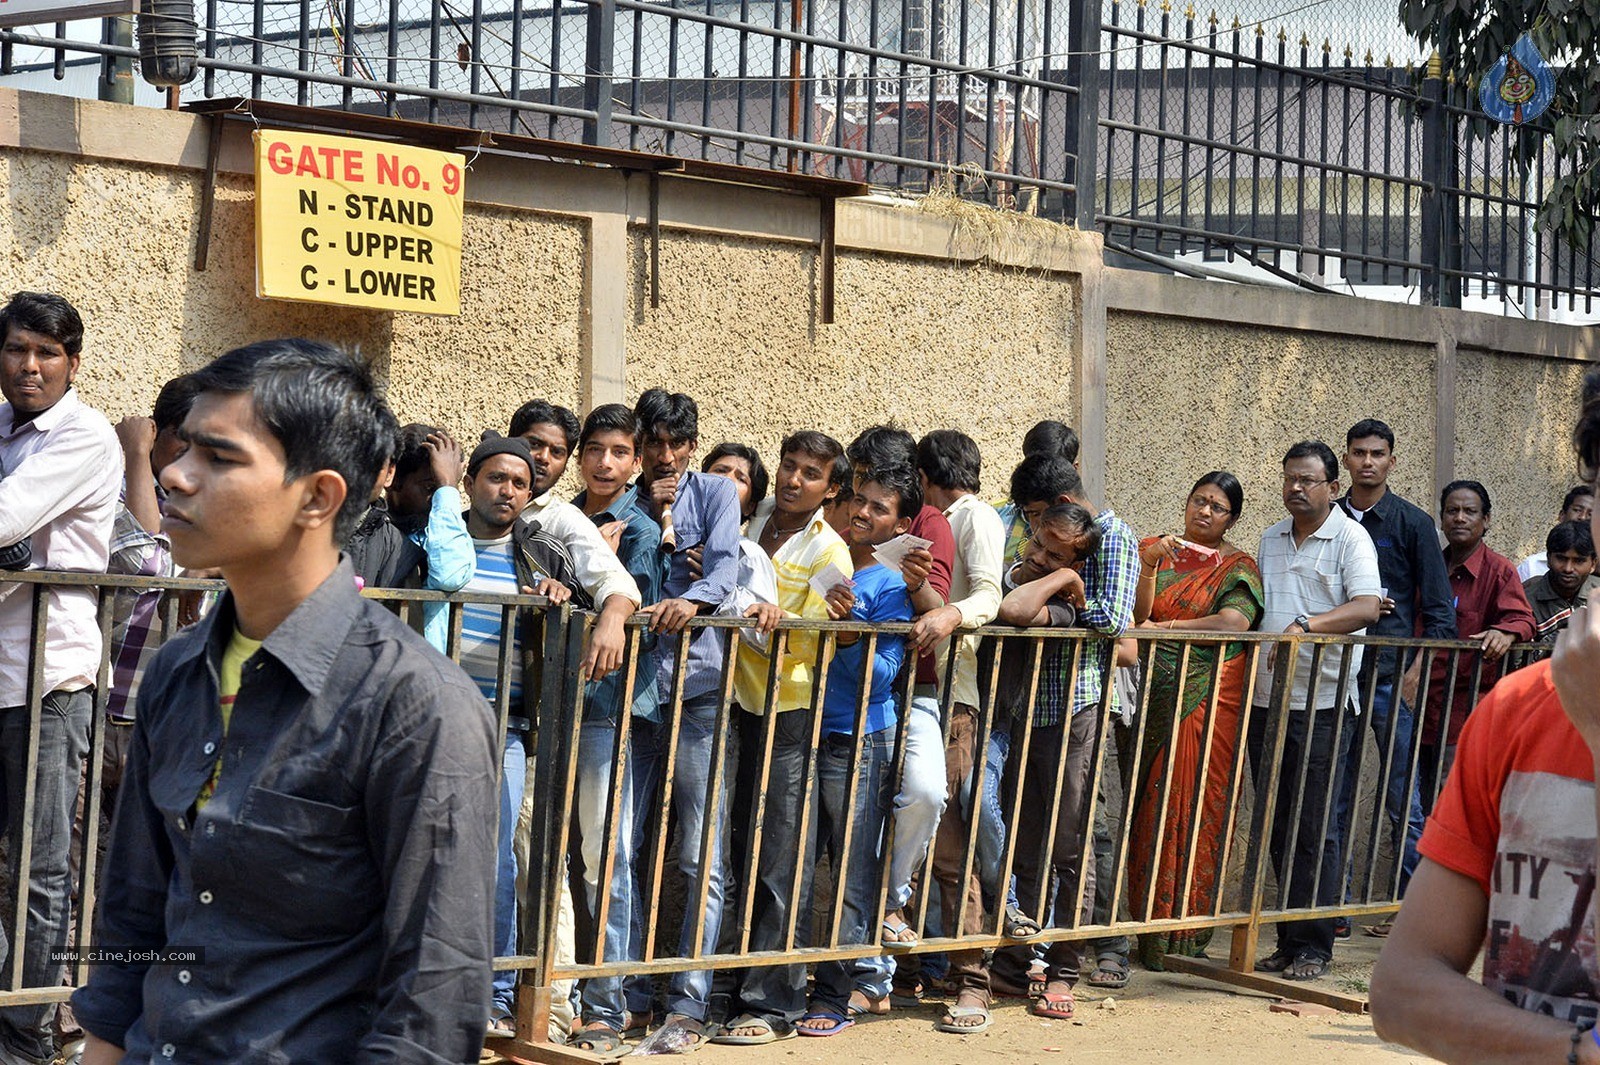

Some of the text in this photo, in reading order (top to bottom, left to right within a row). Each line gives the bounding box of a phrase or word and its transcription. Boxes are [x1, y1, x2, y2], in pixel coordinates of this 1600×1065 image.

[268, 142, 460, 195] GATE No. 9
[299, 189, 318, 215] N
[345, 194, 433, 227] STAND
[301, 227, 319, 252] C
[346, 231, 434, 265] UPPER
[301, 265, 318, 290] C
[345, 269, 436, 301] LOWER
